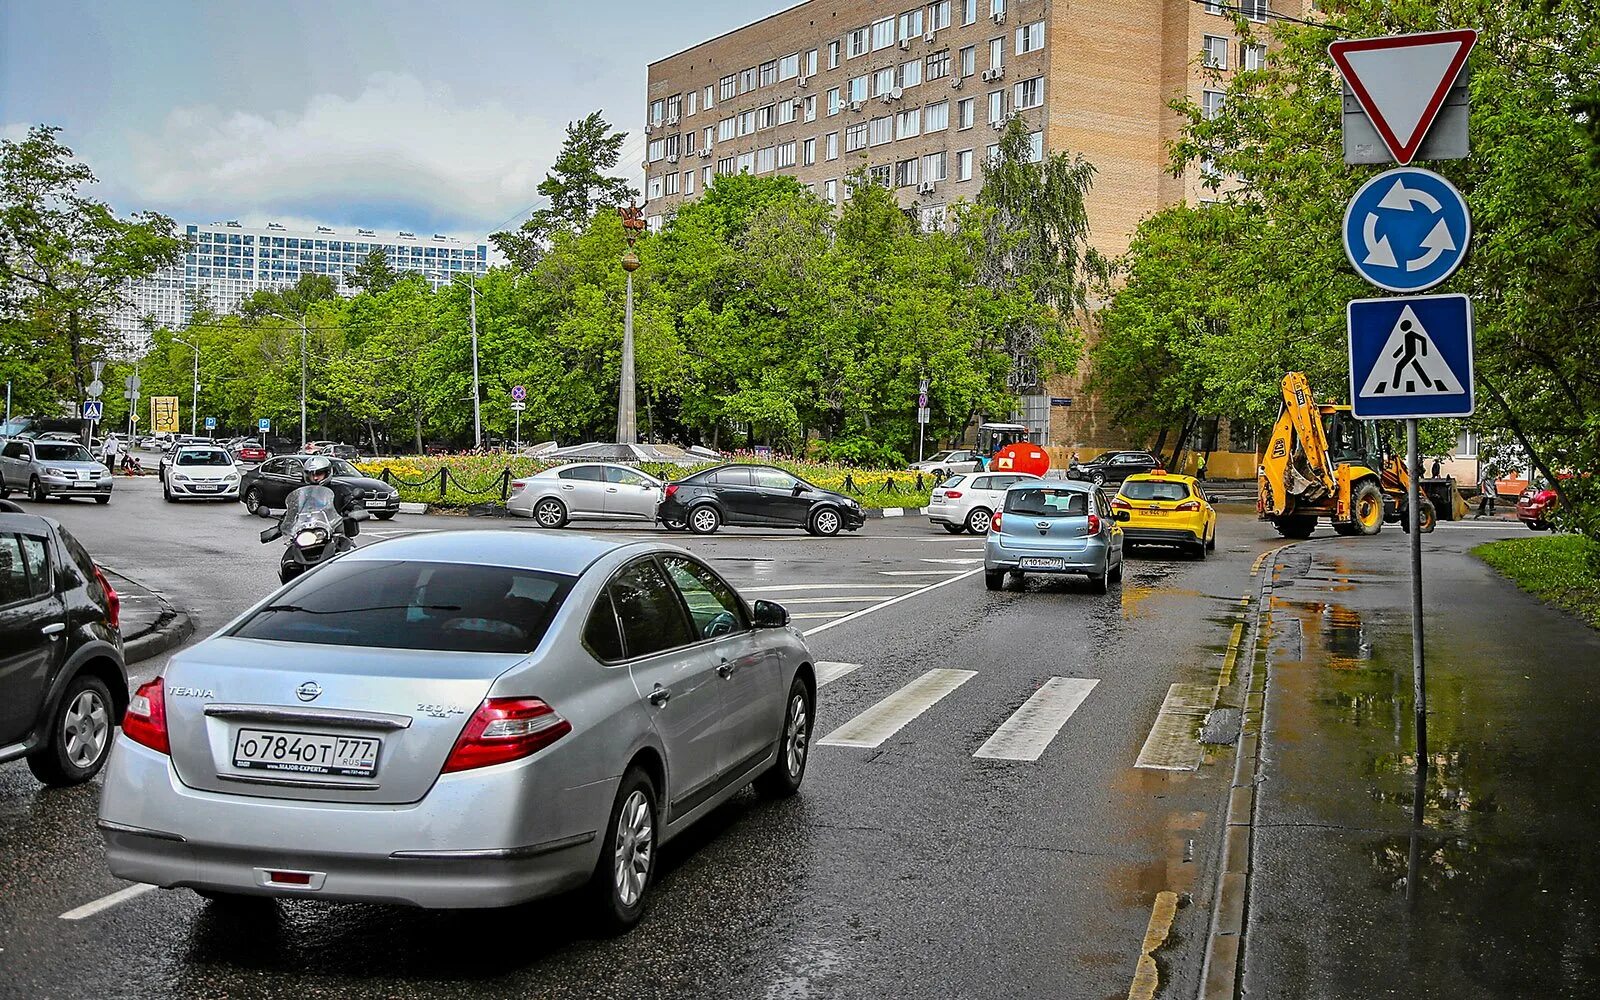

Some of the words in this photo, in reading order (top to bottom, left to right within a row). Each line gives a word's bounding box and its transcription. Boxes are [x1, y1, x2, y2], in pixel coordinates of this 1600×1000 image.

[262, 419, 268, 427] P
[1273, 440, 1285, 456] JCB
[169, 686, 215, 698] TEANA
[416, 703, 444, 713] 250
[447, 705, 465, 714] XL
[338, 740, 372, 759] 777
[343, 758, 360, 767] RUS
